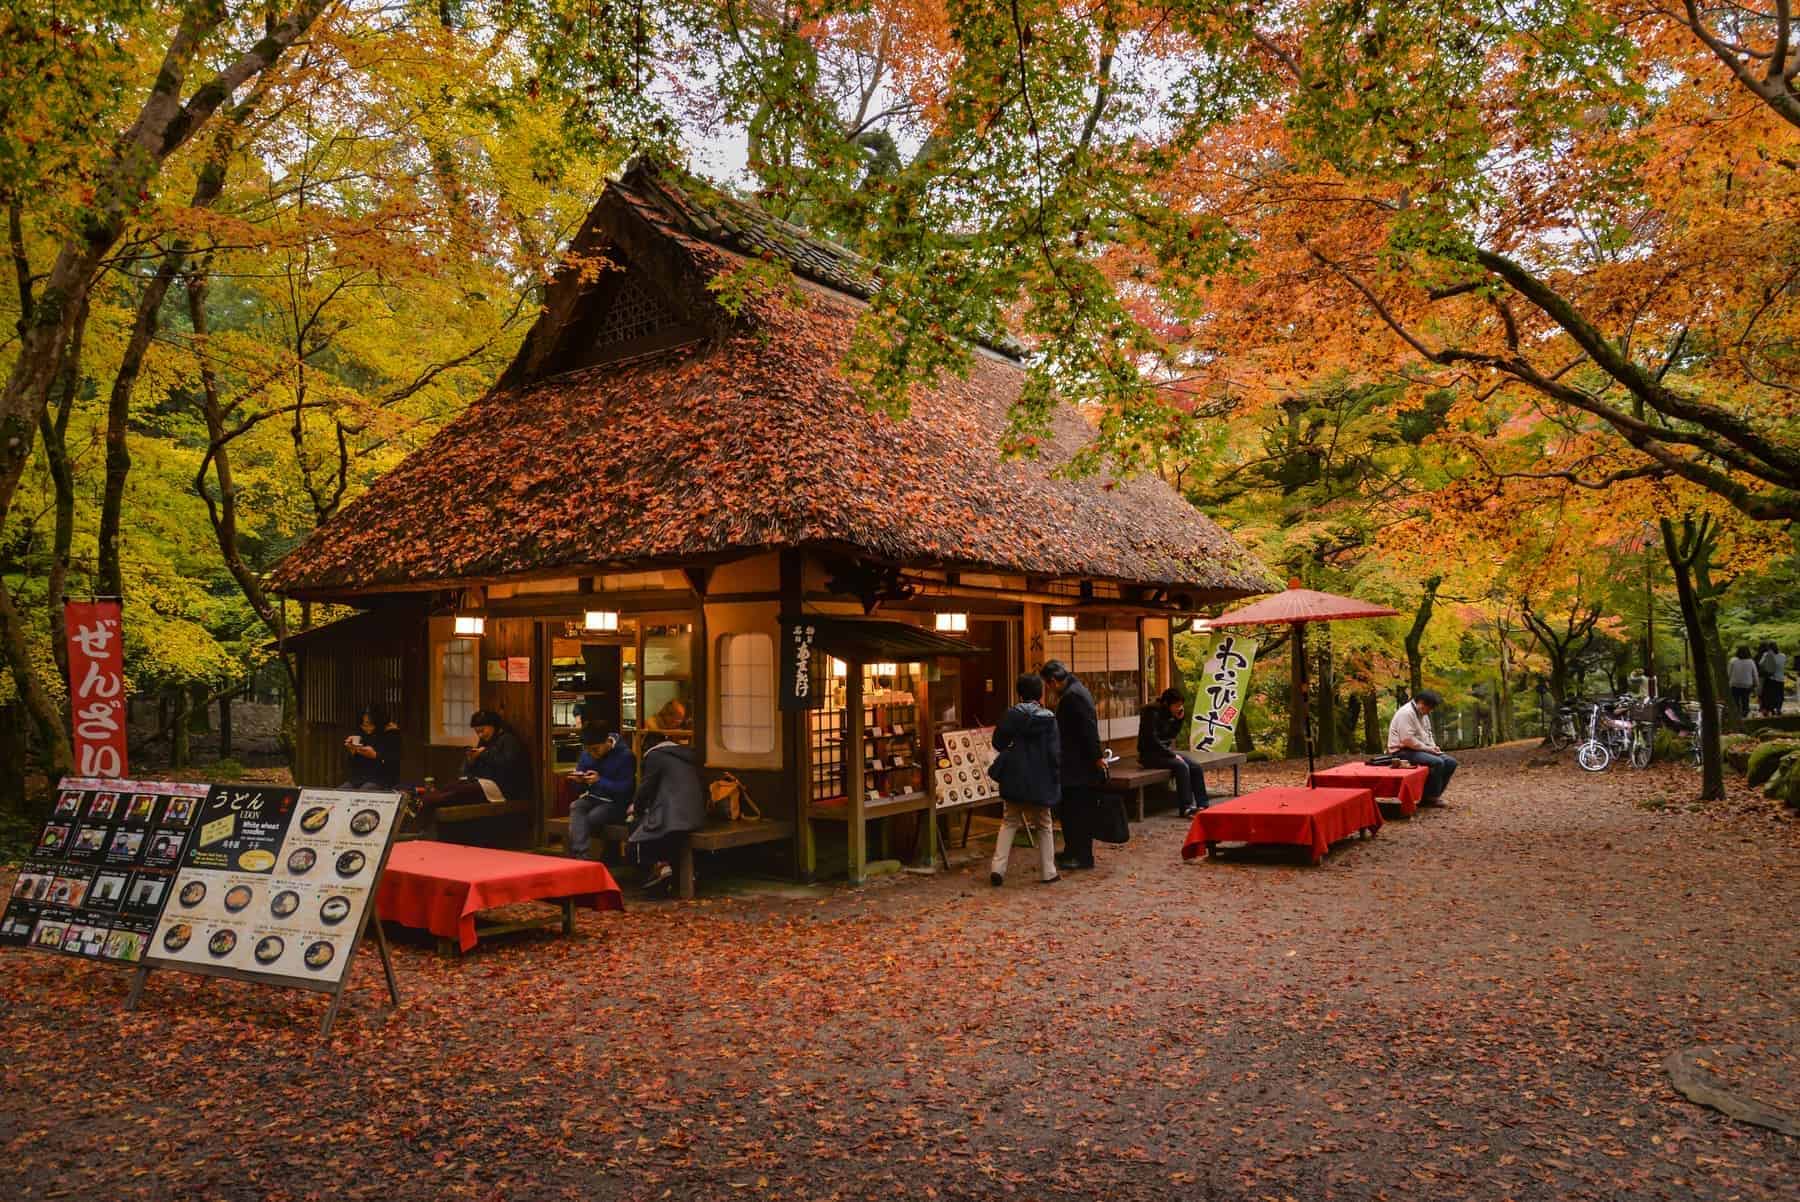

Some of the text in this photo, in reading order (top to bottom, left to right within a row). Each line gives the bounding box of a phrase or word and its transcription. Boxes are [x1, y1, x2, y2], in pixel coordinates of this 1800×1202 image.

[72, 619, 121, 776] ぜんざい
[213, 791, 264, 811] うどん
